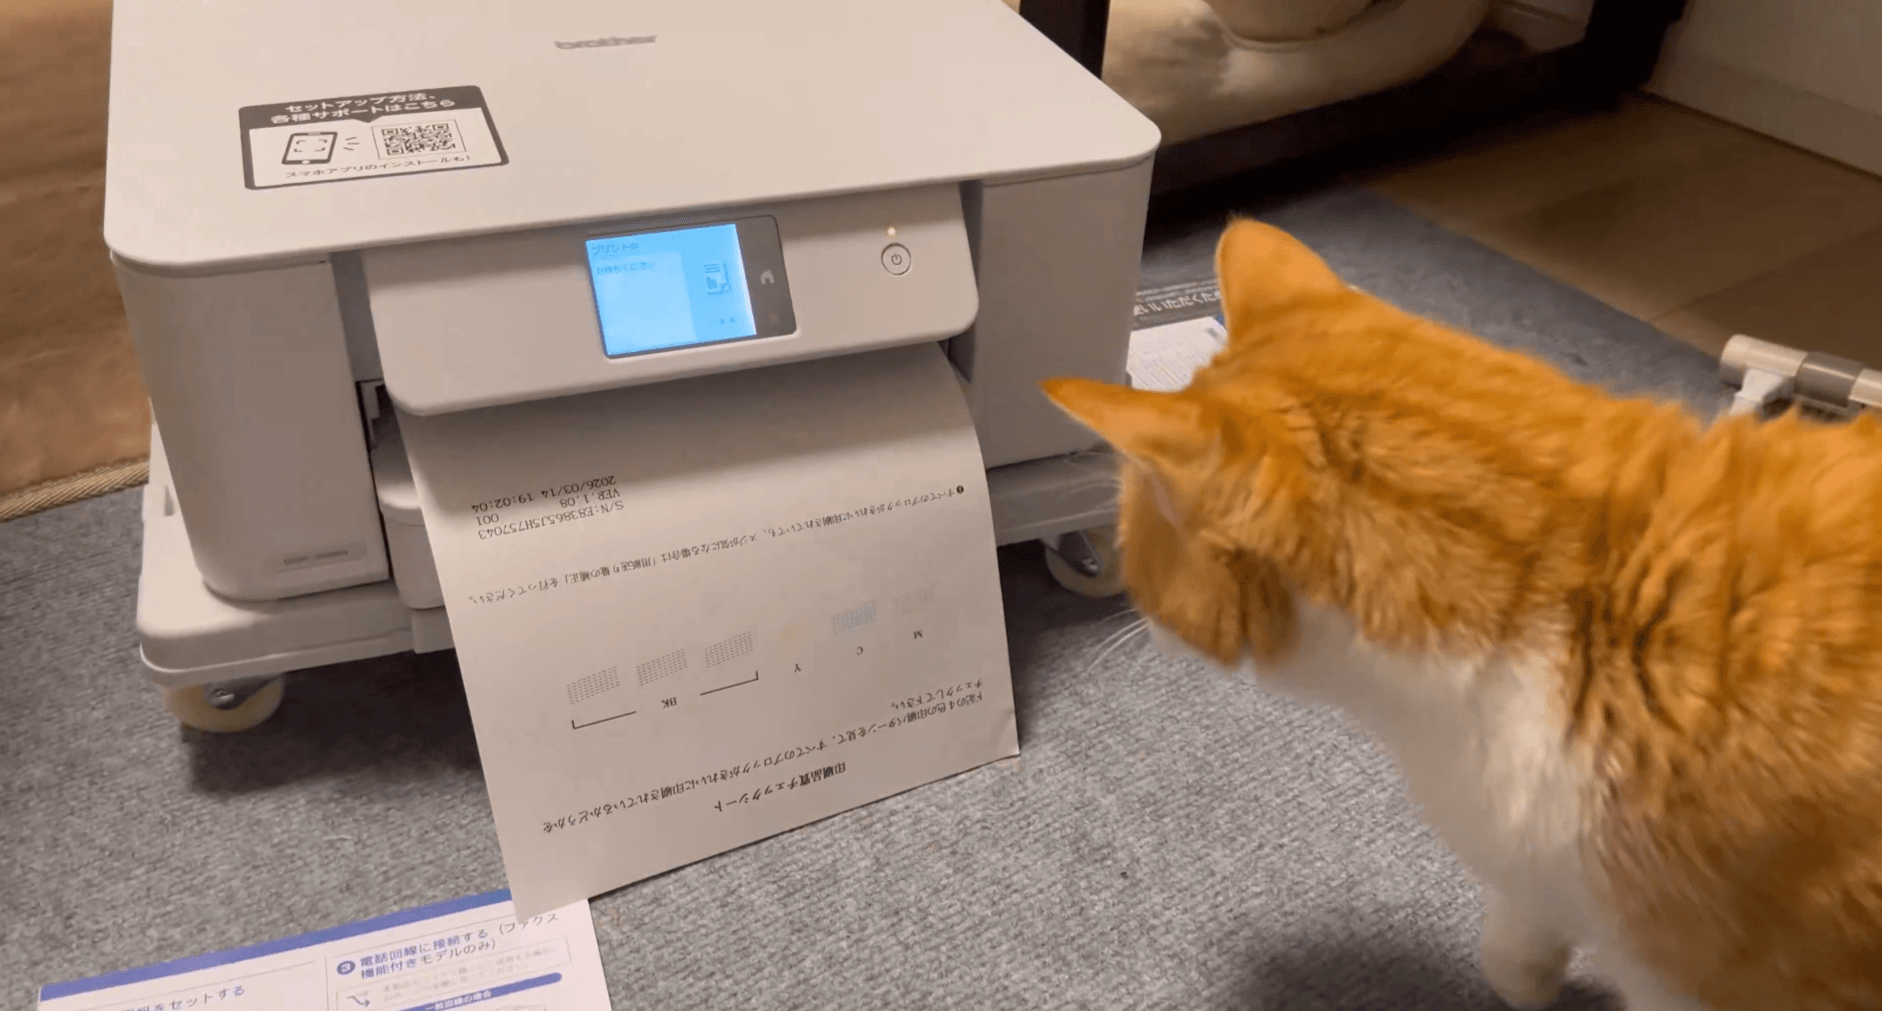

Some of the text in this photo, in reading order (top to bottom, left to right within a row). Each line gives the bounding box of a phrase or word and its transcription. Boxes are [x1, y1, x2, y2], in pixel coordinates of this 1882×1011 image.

[554, 35, 657, 50] brother
[270, 98, 456, 125] 各種サポートはこちら
[471, 475, 617, 514] 2026/03/14 19:02:04
[476, 488, 621, 527] VER.1.08 001
[661, 629, 923, 709] M C Y BK
[713, 761, 847, 813] 印刷品質チェックシート
